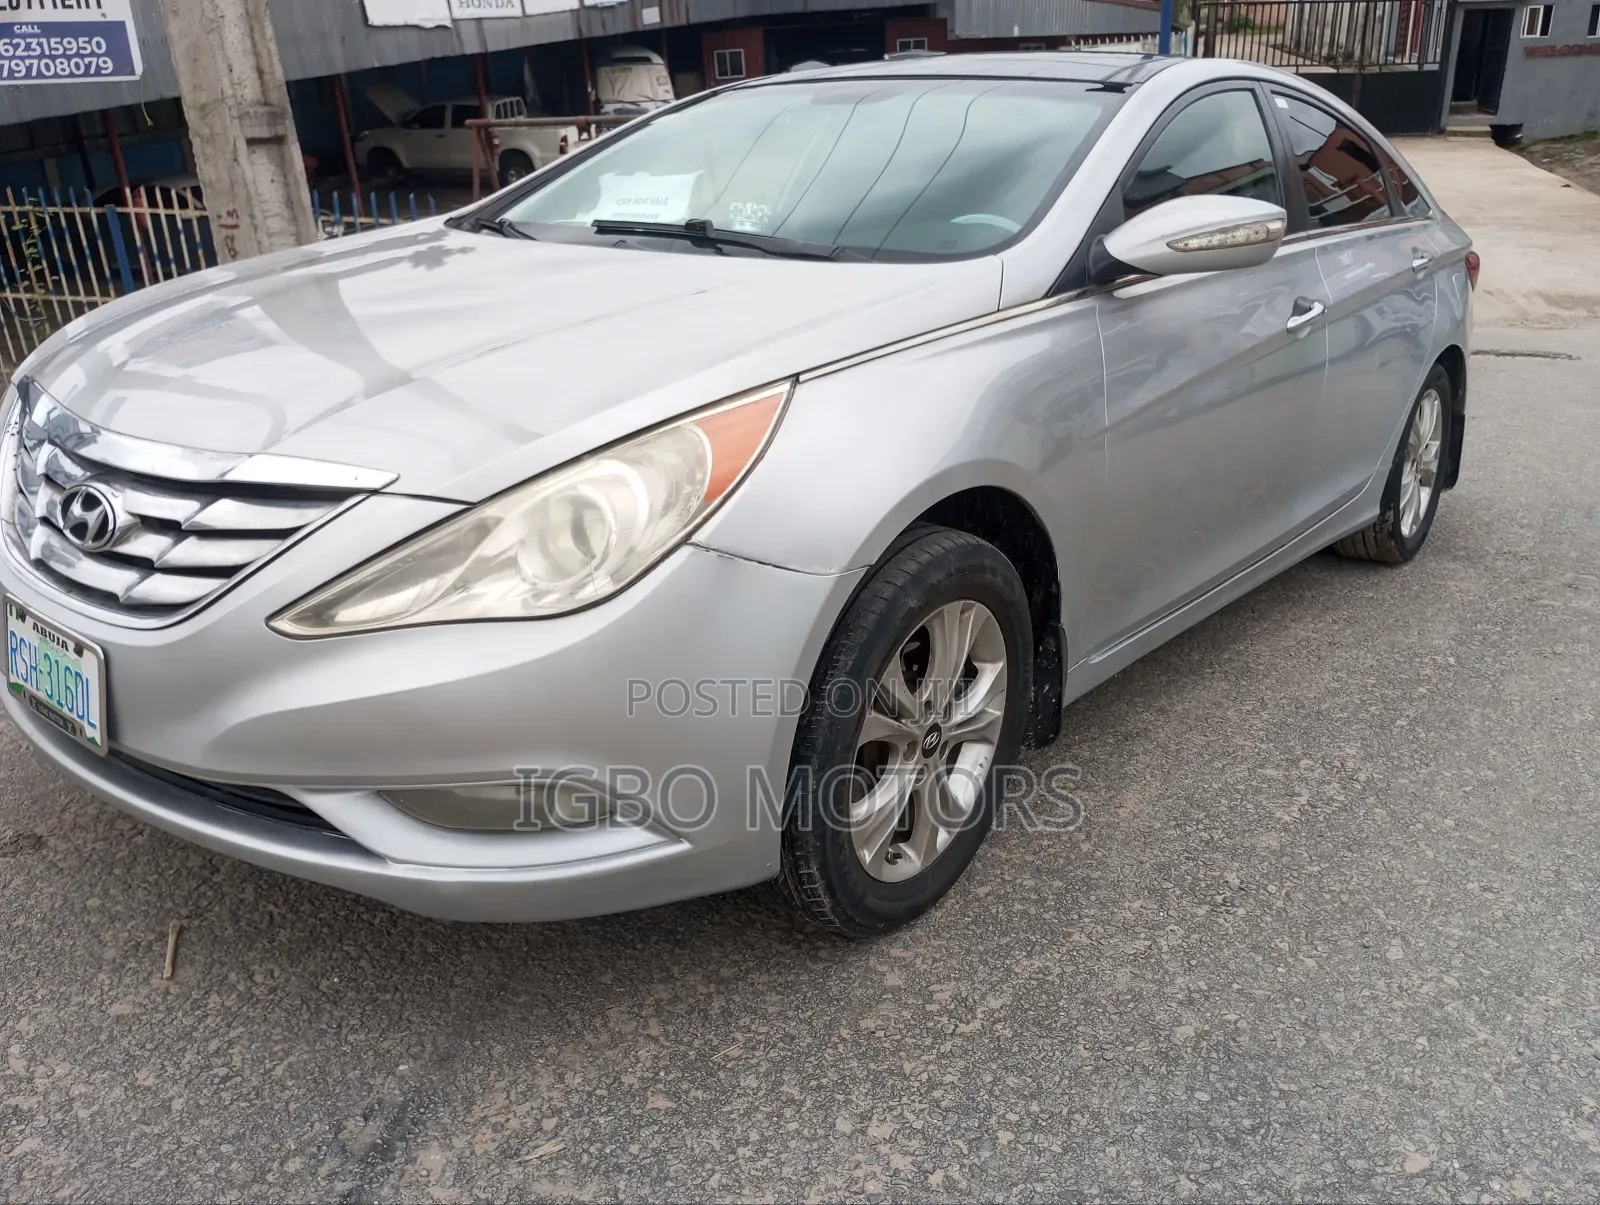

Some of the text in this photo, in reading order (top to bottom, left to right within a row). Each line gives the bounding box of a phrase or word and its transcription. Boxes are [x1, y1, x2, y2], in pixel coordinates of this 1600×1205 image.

[13, 24, 41, 34] CALL
[0, 36, 107, 57] 62315950
[0, 57, 114, 78] 79708079
